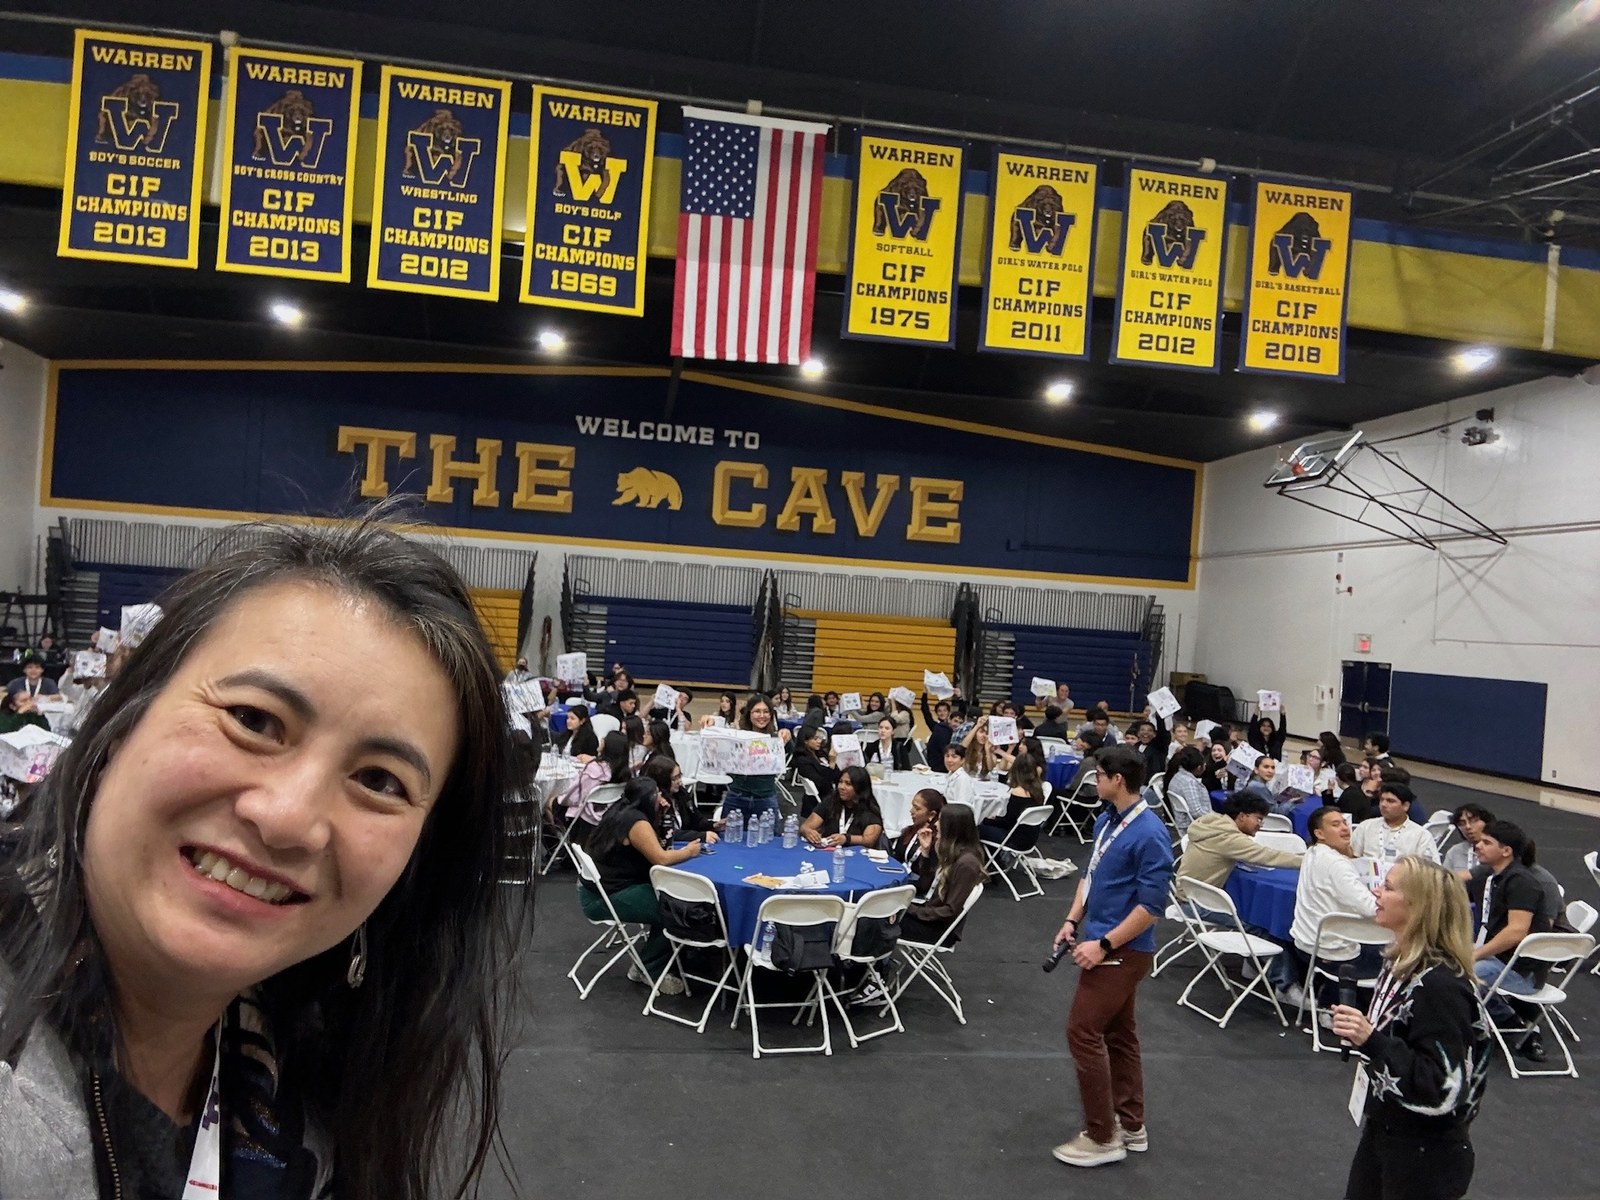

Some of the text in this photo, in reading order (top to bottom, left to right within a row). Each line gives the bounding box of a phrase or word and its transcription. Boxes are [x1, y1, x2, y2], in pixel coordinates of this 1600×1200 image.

[92, 46, 194, 71] WARREN
[245, 63, 345, 88] WARREN
[398, 81, 494, 109] WARREN
[548, 101, 641, 128] WARREN
[89, 151, 180, 169] BOY'S SOCCER
[870, 144, 954, 168] WARREN
[264, 169, 295, 181] CROSS
[297, 172, 344, 186] COUNTRY
[1006, 162, 1089, 183] WARREN
[107, 173, 161, 197] CIF
[401, 185, 477, 203] WRESTLING
[1139, 178, 1219, 200] WARREN
[76, 196, 187, 221] CHAMPIONS
[262, 188, 315, 212] CIF
[1266, 190, 1344, 211] WARREN
[232, 210, 340, 236] CHAMPIONS
[413, 207, 464, 231] CIF
[555, 203, 622, 221] BOY'S GOLF
[93, 221, 166, 247] 2013
[384, 227, 489, 255] CHAMPIONS
[563, 224, 611, 247] CIF
[249, 236, 319, 262] 2013
[536, 243, 635, 271] CHAMPIONS
[876, 242, 933, 257] SOFTBALL
[400, 253, 468, 281] 2012
[882, 262, 925, 283] CIF
[1027, 260, 1059, 271] WATER
[1062, 263, 1083, 272] POLO
[551, 269, 617, 297] 1969
[1018, 278, 1060, 297] CIF
[1159, 273, 1190, 284] WATER
[1192, 277, 1212, 287] POLO
[1285, 283, 1341, 295] BASKETBALL
[856, 283, 948, 304] CHAMPIONS
[1150, 291, 1191, 310] CIF
[870, 306, 929, 329] 1975
[993, 298, 1083, 318] CHAMPIONS
[1277, 300, 1317, 319] CIF
[1011, 320, 1061, 342] 2011
[1125, 310, 1212, 331] CHAMPIONS
[1252, 320, 1338, 339] CHAMPIONS
[1138, 333, 1195, 355] 2012
[1265, 343, 1321, 364] 2018
[575, 415, 760, 450] WELCOME TO
[337, 425, 964, 544] THE CAVE
